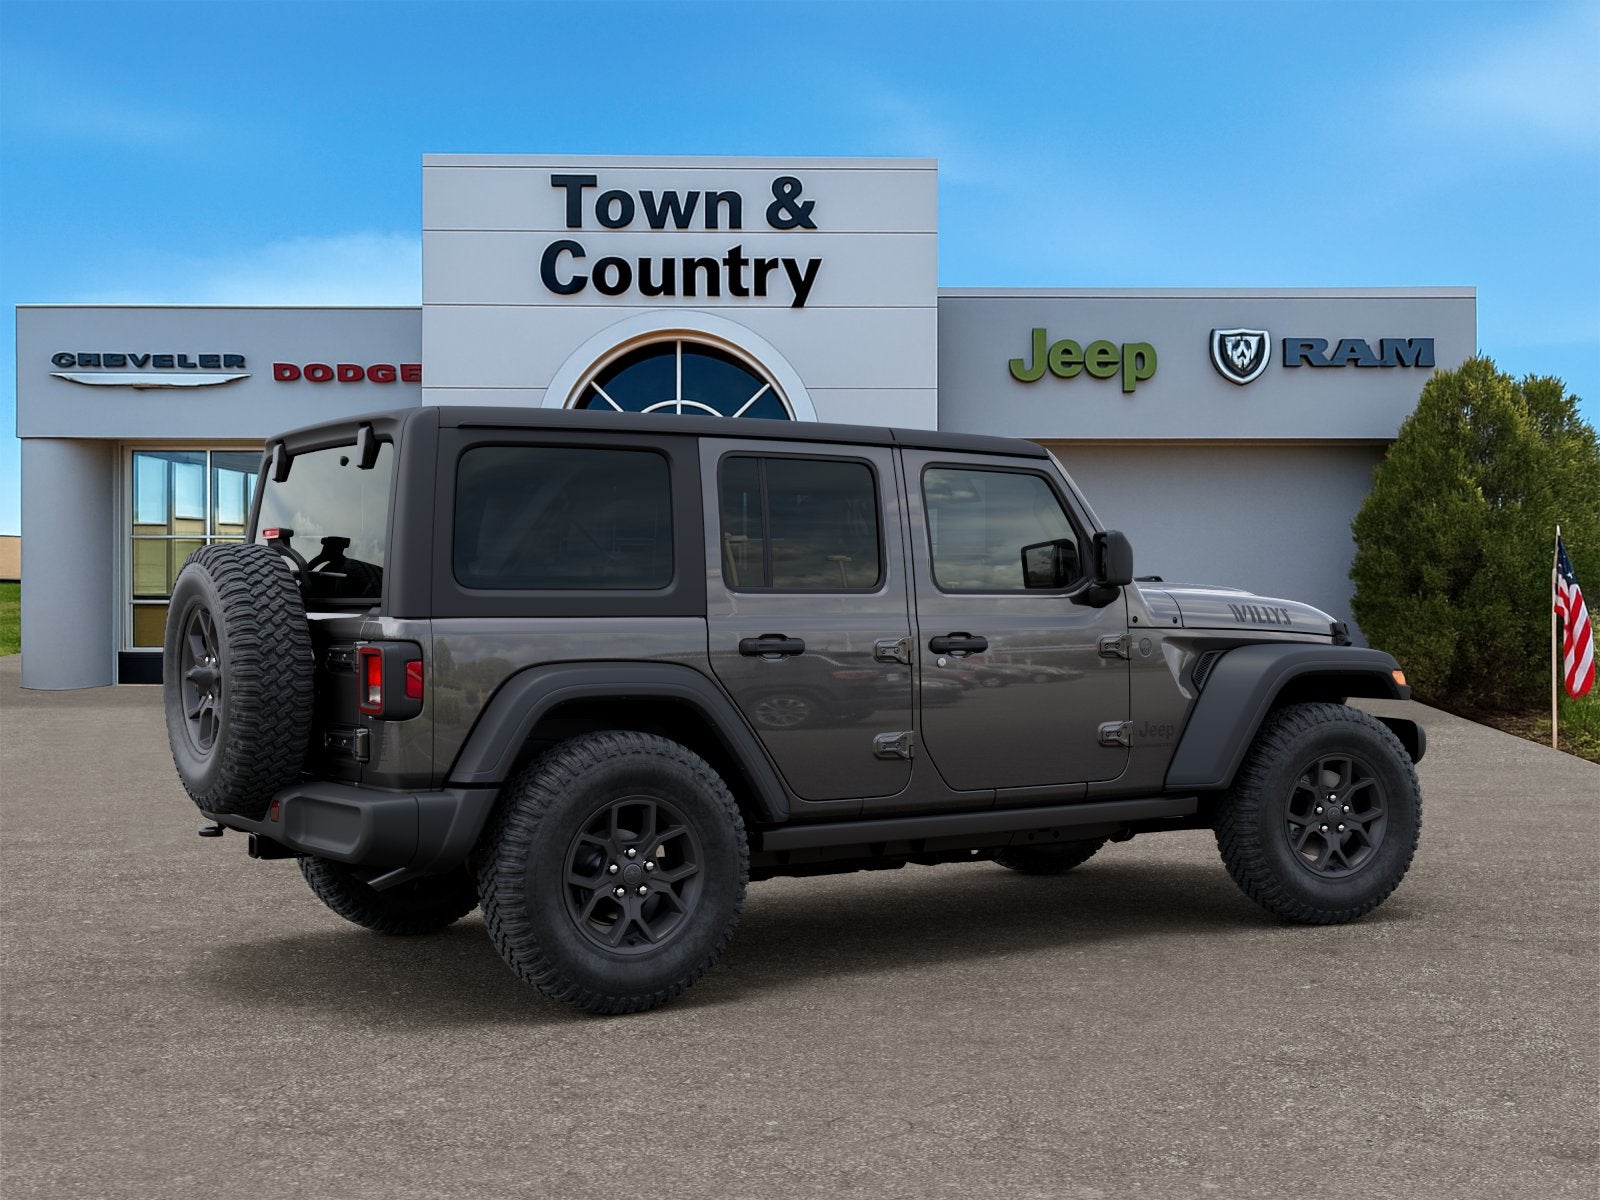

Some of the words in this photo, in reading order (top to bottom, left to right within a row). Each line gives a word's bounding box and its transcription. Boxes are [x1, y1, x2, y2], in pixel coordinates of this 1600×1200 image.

[550, 173, 742, 229] Town
[765, 175, 818, 230] &
[540, 239, 822, 308] Country
[1009, 327, 1158, 393] Jeep
[1282, 337, 1436, 367] RAM
[273, 363, 422, 383] DODGE
[1228, 603, 1292, 626] WILLYS
[1138, 721, 1175, 740] Jeep
